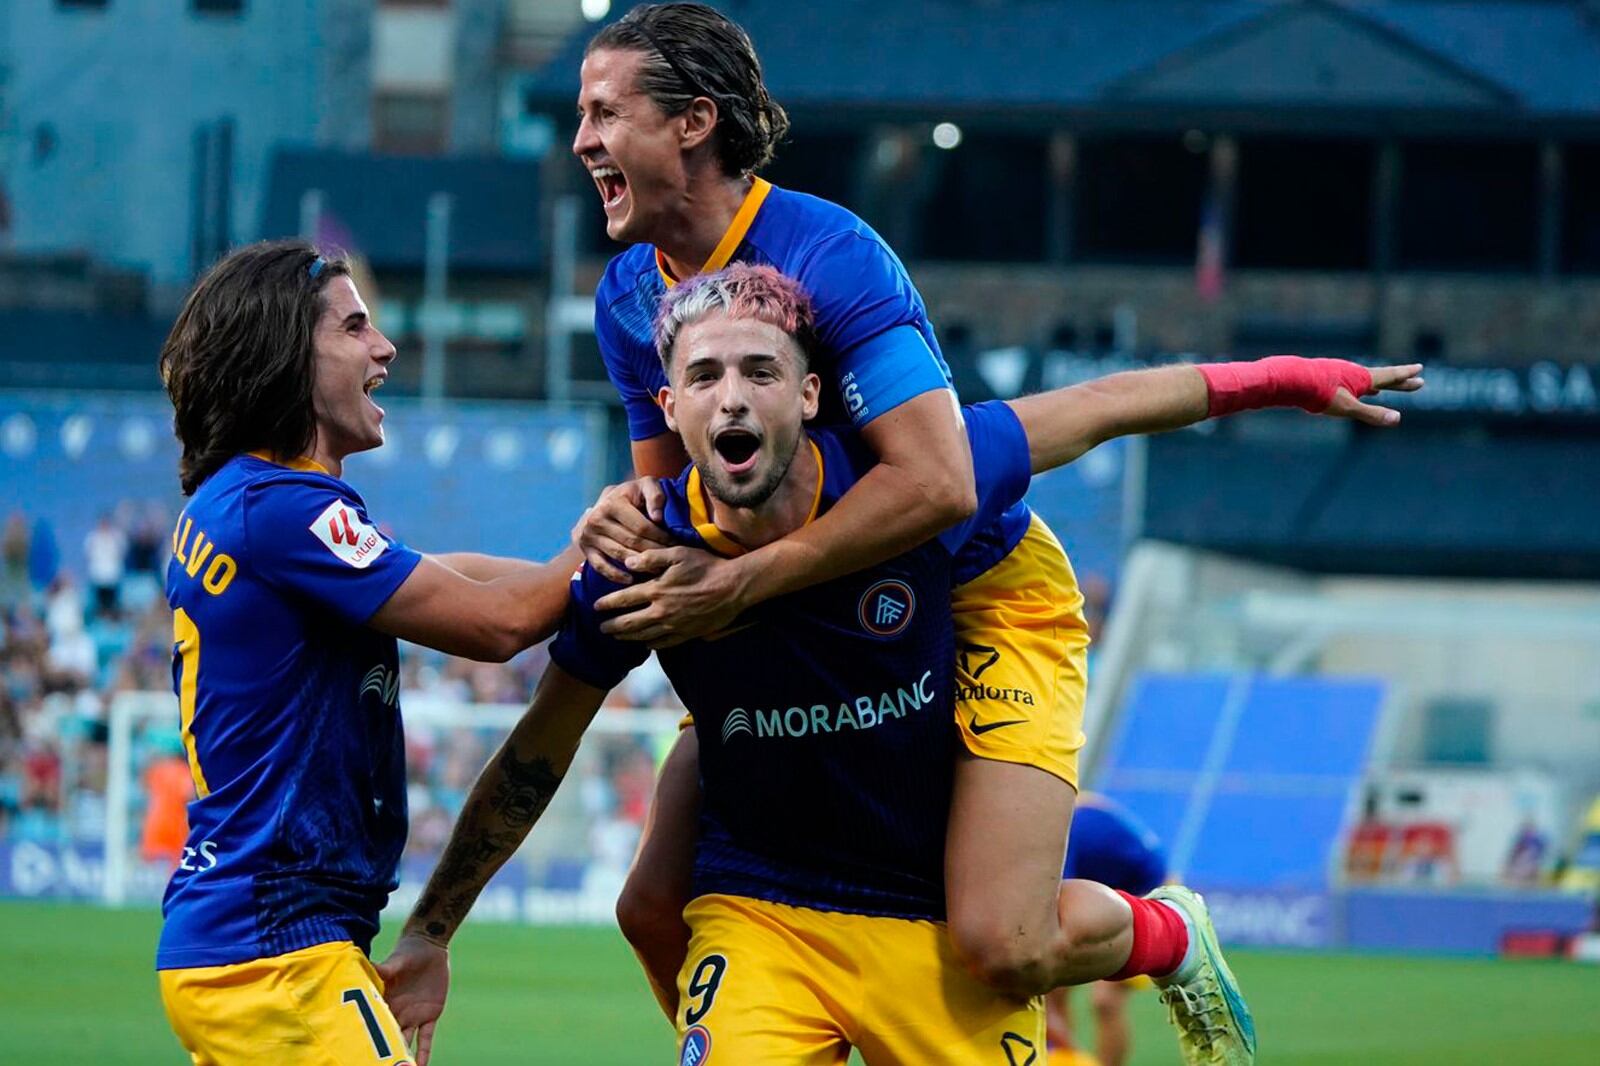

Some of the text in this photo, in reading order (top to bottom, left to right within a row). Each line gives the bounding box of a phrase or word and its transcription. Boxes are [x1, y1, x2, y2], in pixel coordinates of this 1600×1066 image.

[172, 509, 237, 595] LVO
[755, 670, 935, 738] MORABANC
[342, 987, 393, 1059] 1
[685, 953, 728, 1026] 9
